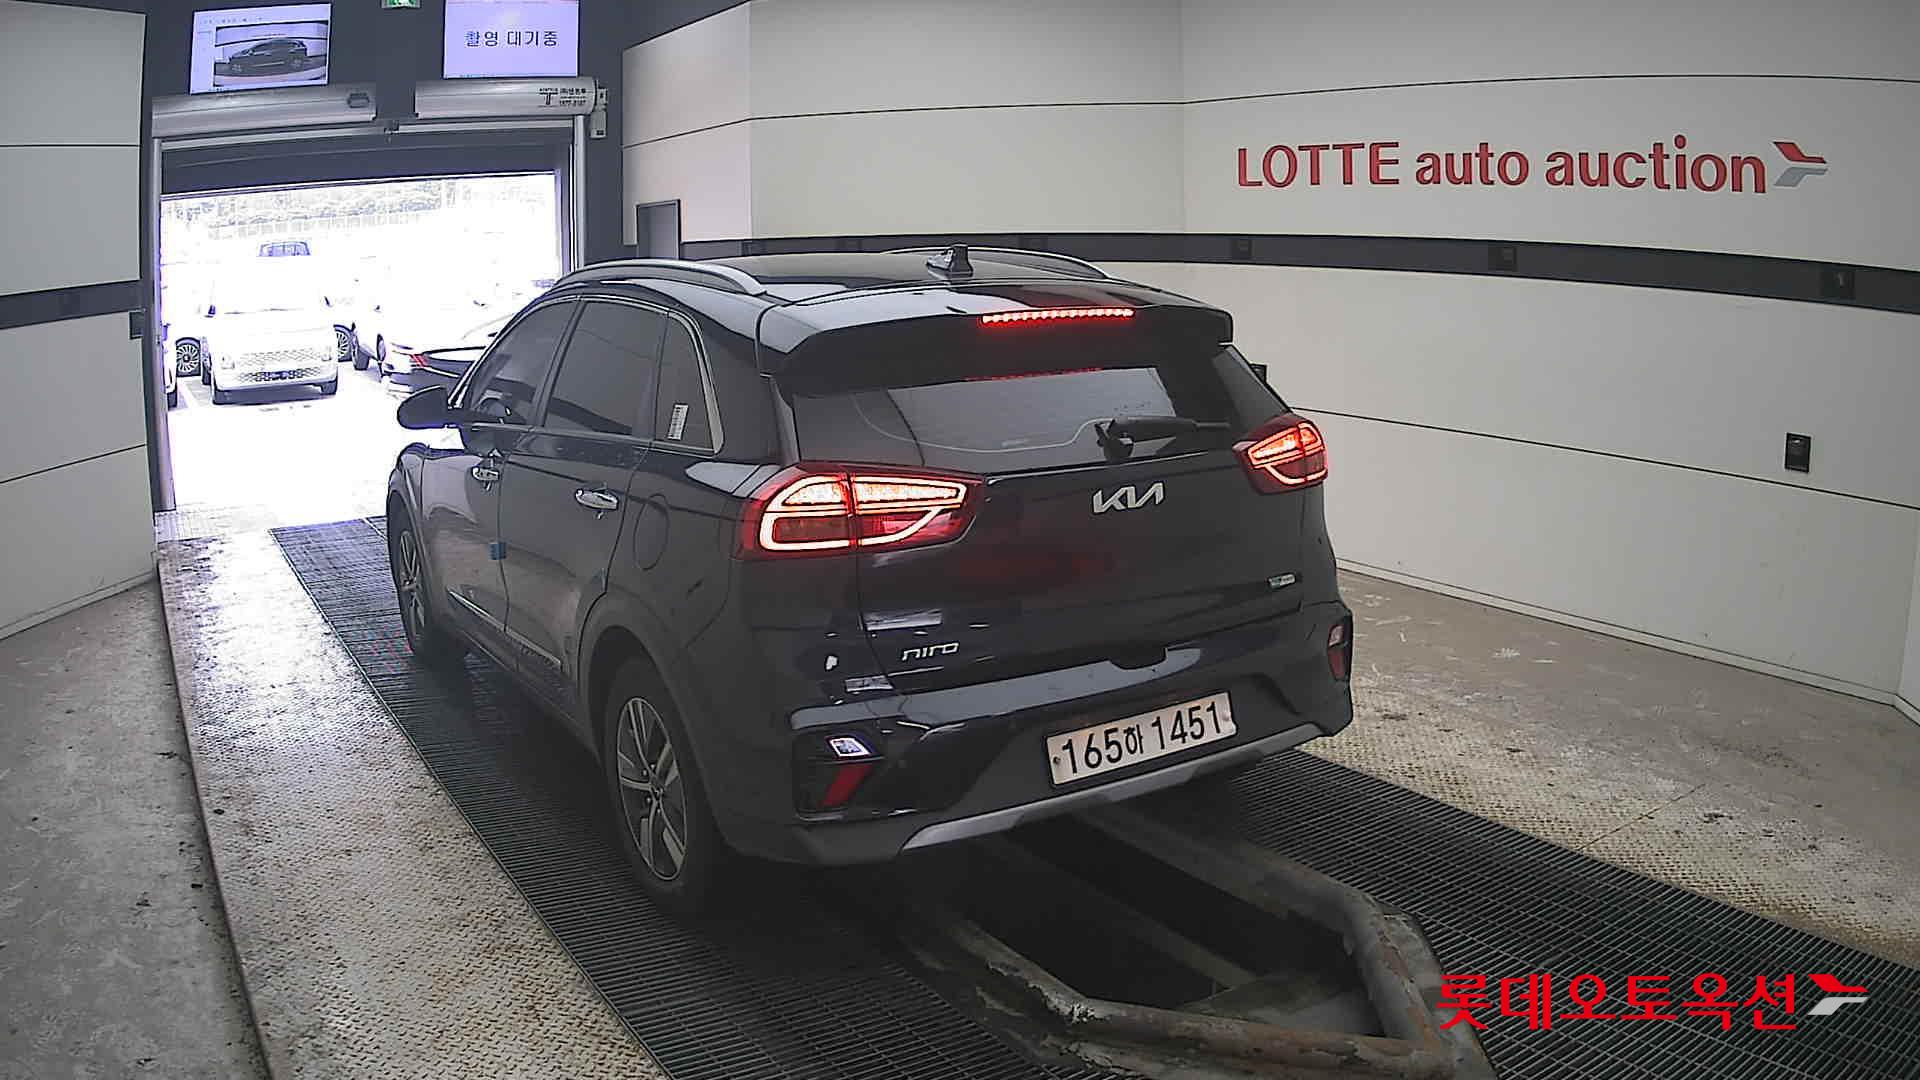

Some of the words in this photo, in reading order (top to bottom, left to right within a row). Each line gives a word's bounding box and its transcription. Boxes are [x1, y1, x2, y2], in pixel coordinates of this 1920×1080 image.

[506, 30, 558, 48] 대기중
[1237, 141, 1400, 188] LOTTE
[1415, 142, 1530, 186] auto
[1544, 134, 1767, 194] auction
[1092, 482, 1164, 513] KIA
[1061, 723, 1145, 775] 165하
[1151, 701, 1222, 751] 1451
